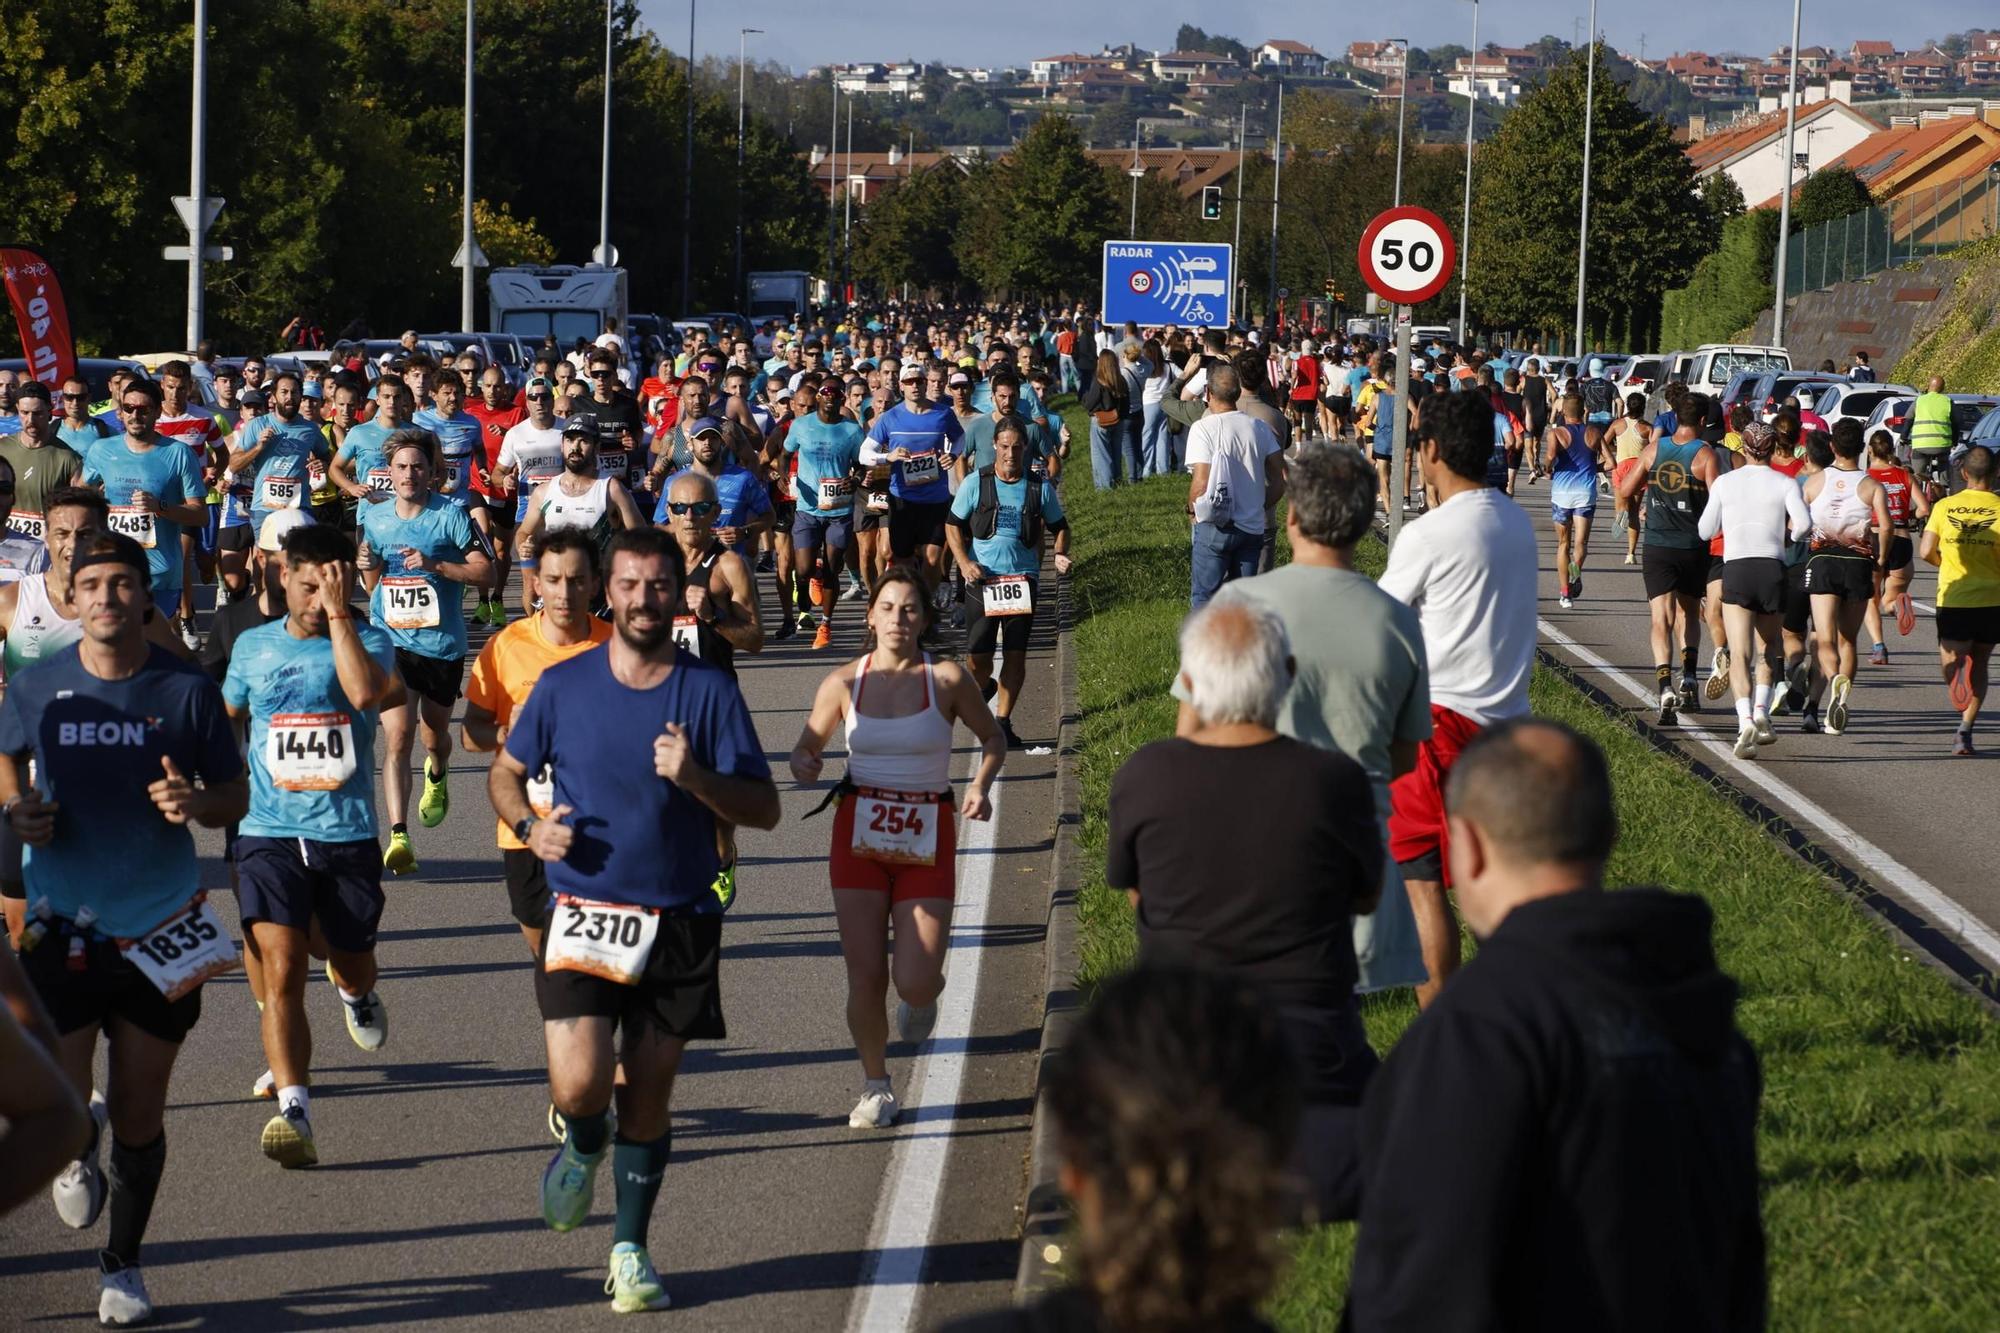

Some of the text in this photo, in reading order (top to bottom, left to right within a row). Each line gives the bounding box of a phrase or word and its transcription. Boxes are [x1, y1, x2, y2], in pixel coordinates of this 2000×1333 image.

[1110, 247, 1153, 258] RADAR
[1380, 239, 1434, 273] 50
[1134, 278, 1148, 287] 50
[904, 457, 935, 475] 2322
[269, 484, 294, 498] 585
[1947, 506, 1998, 517] WOLVES
[5, 518, 41, 537] 2428
[109, 514, 150, 534] 2483
[389, 586, 430, 608] 1475
[990, 583, 1022, 601] 1186
[58, 722, 145, 746] BEON
[275, 729, 344, 761] 1440
[869, 803, 924, 836] 254
[138, 903, 218, 967] 1835
[563, 910, 642, 948] 2310
